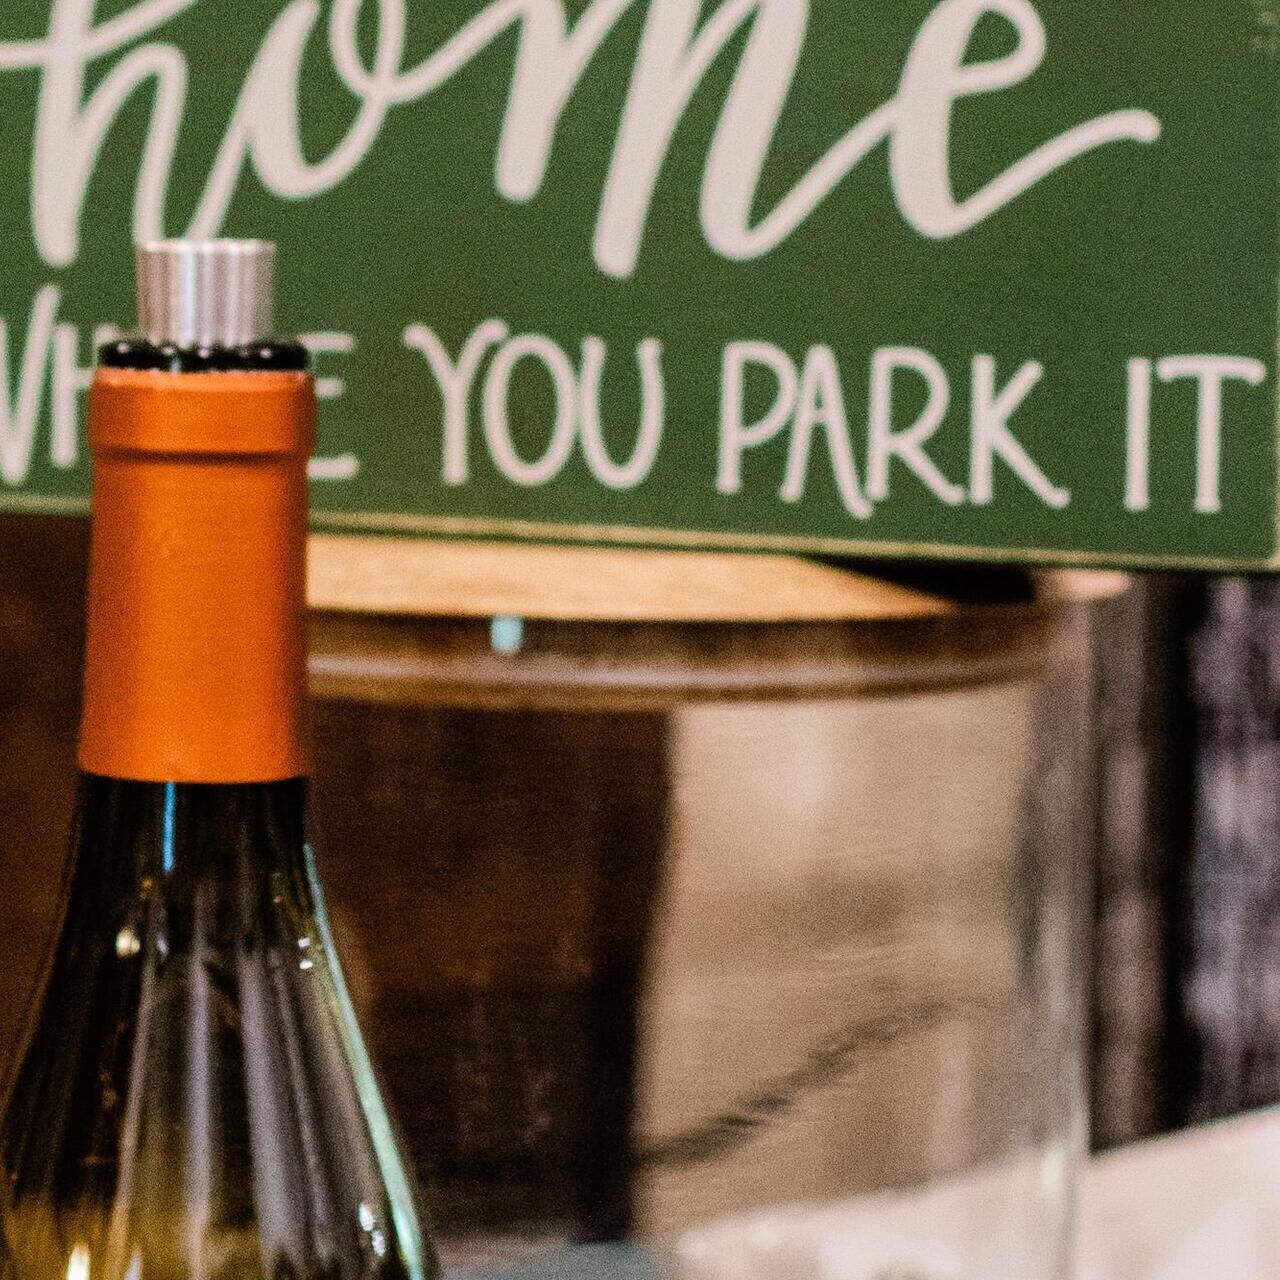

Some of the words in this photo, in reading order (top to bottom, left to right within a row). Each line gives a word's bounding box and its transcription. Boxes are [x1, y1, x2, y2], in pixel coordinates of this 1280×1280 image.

[402, 319, 665, 488] YOU
[715, 341, 1071, 519] PARK
[1124, 354, 1268, 513] IT
